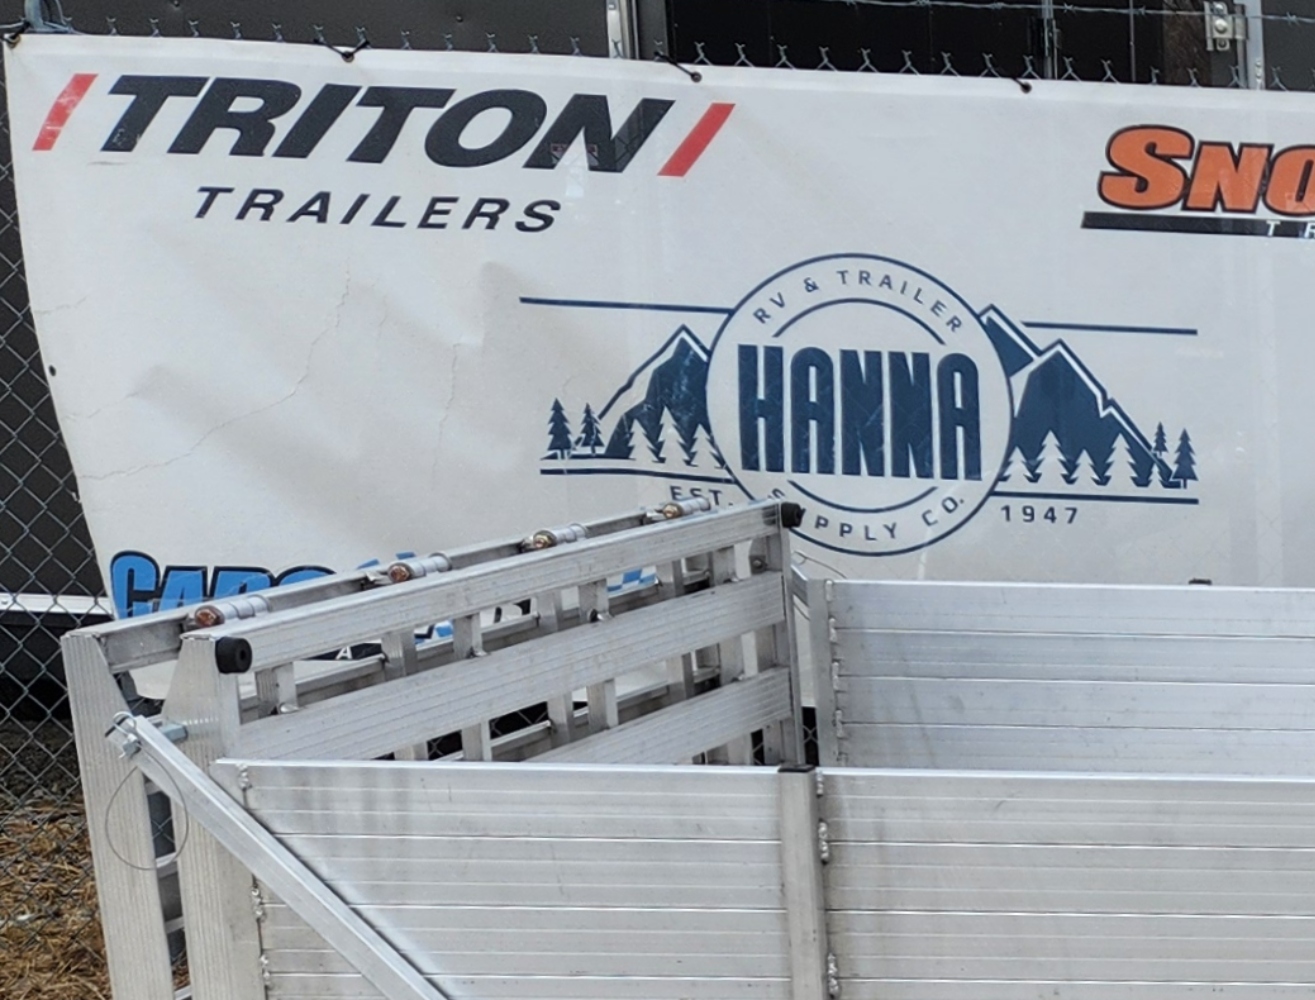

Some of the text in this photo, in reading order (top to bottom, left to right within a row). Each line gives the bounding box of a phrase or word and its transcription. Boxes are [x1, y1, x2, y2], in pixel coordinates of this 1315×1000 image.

[100, 74, 676, 174] TRITON
[195, 186, 562, 233] TRAILERS
[753, 269, 963, 332] RV & TRAILER
[738, 343, 982, 481] HANNA
[921, 495, 965, 527] CO.
[1000, 504, 1079, 525] 1947
